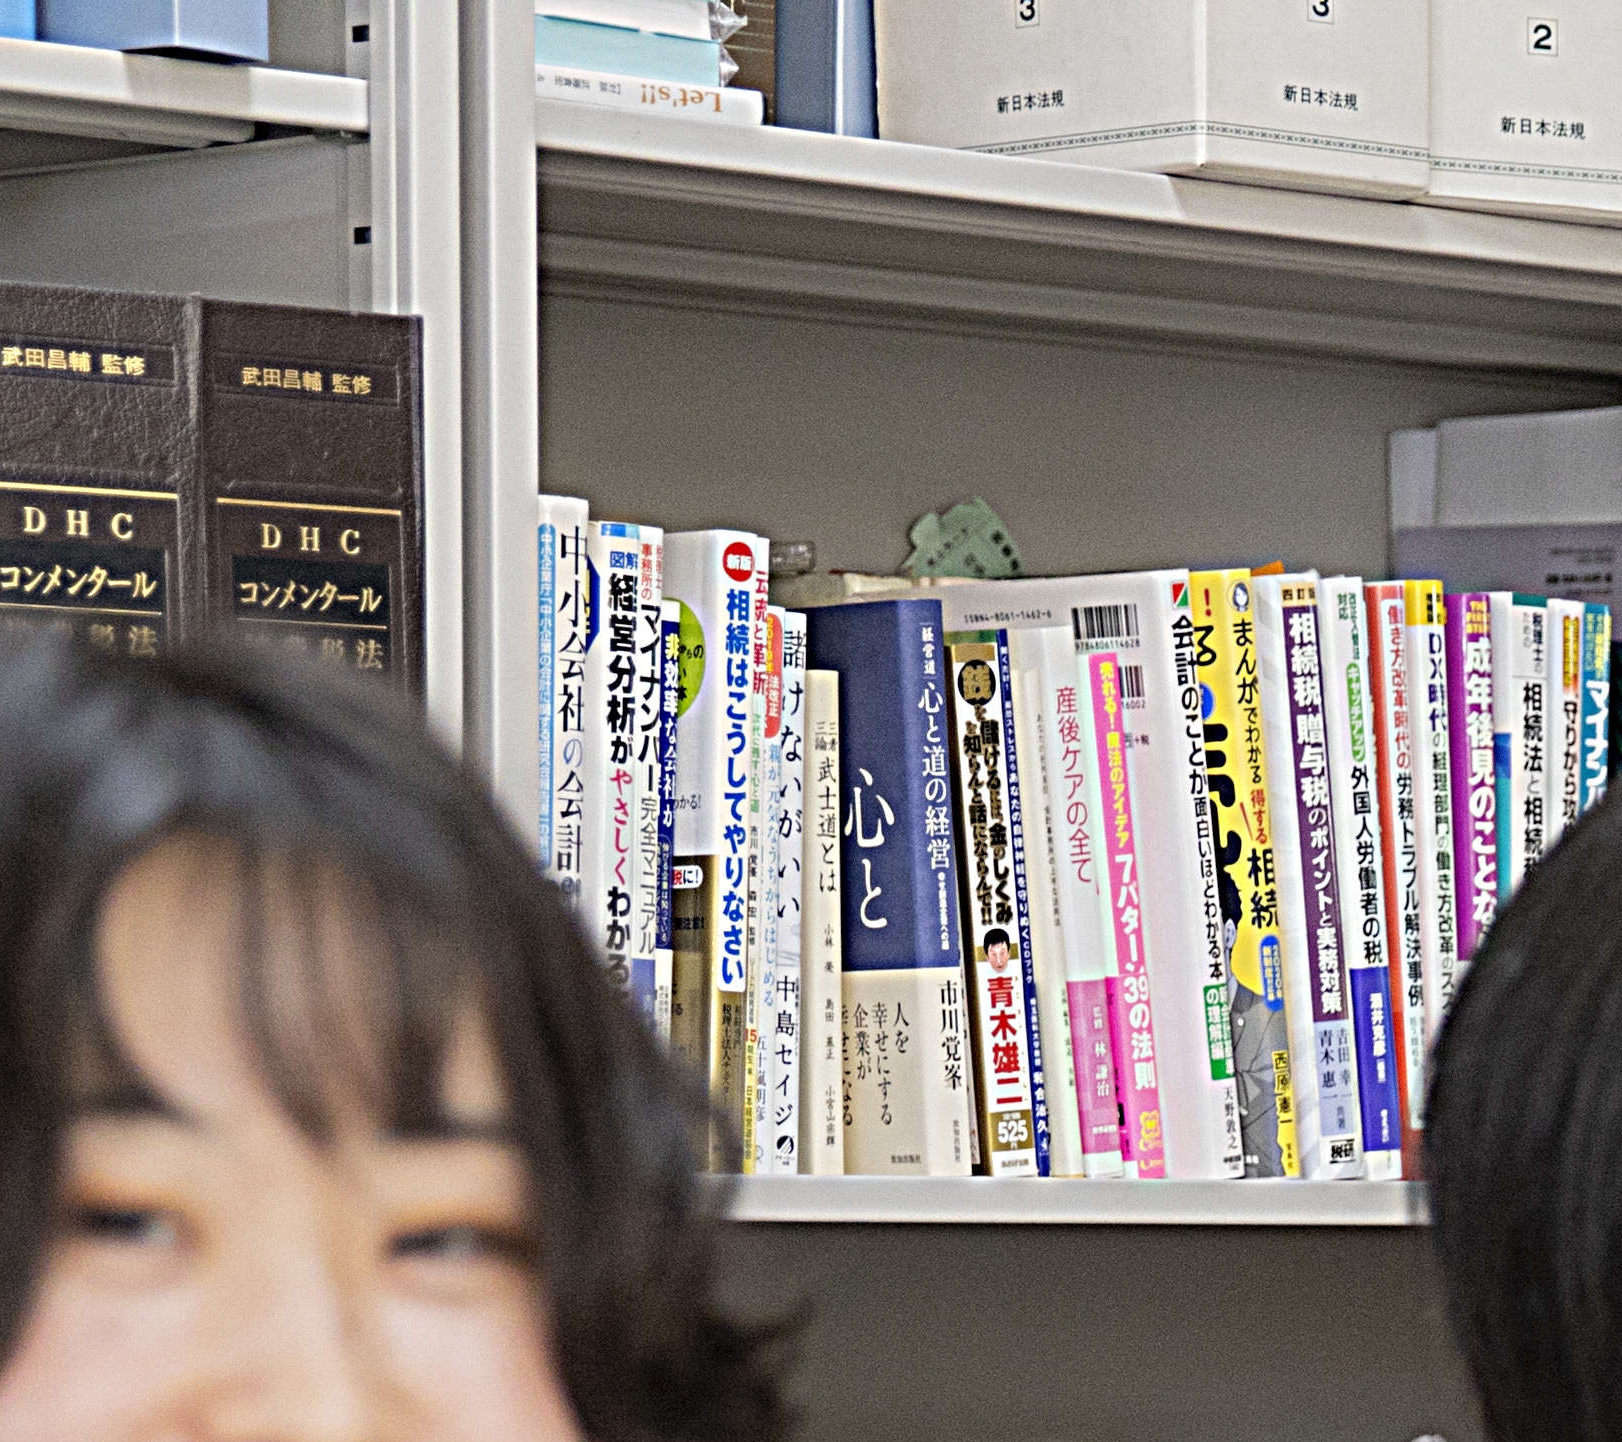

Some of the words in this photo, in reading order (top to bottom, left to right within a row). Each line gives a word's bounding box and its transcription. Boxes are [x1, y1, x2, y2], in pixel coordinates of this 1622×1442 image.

[1533, 23, 1553, 53] 2
[640, 83, 724, 114] Let's!!
[996, 88, 1066, 115] 新日本法規
[1283, 83, 1360, 113] 新日本法規
[1500, 114, 1587, 141] 新日本法規
[0, 345, 93, 376] 武田昌輔
[101, 352, 147, 378] 監修
[241, 364, 323, 394] 武田昌輔
[331, 372, 374, 398] 監修
[609, 551, 639, 571] 図解
[725, 553, 754, 572] 新版
[239, 578, 383, 617] コンメンタール
[1231, 618, 1263, 786] まんがでわかる
[1249, 787, 1268, 845] 得する
[1346, 665, 1366, 763] キャッチアップ
[720, 588, 751, 986] 相続はこうしてやりなさい
[917, 681, 952, 871] 心と道の経営
[1055, 684, 1093, 884] 産後ケアの全て
[1170, 614, 1228, 981] 会計のことが面白いほどわかる本
[1288, 612, 1343, 1014] 相続税・贈与税のポイントと実務対策
[843, 767, 896, 930] 心と
[774, 975, 796, 1127] 中島セイジ
[853, 1002, 873, 1082] 企業が
[892, 1001, 911, 1055] 人を
[986, 974, 1024, 1106] 青木雄二
[1336, 1028, 1354, 1098] 吉田幸一
[872, 1002, 894, 1127] 幸せにする
[996, 1120, 1029, 1144] 525
